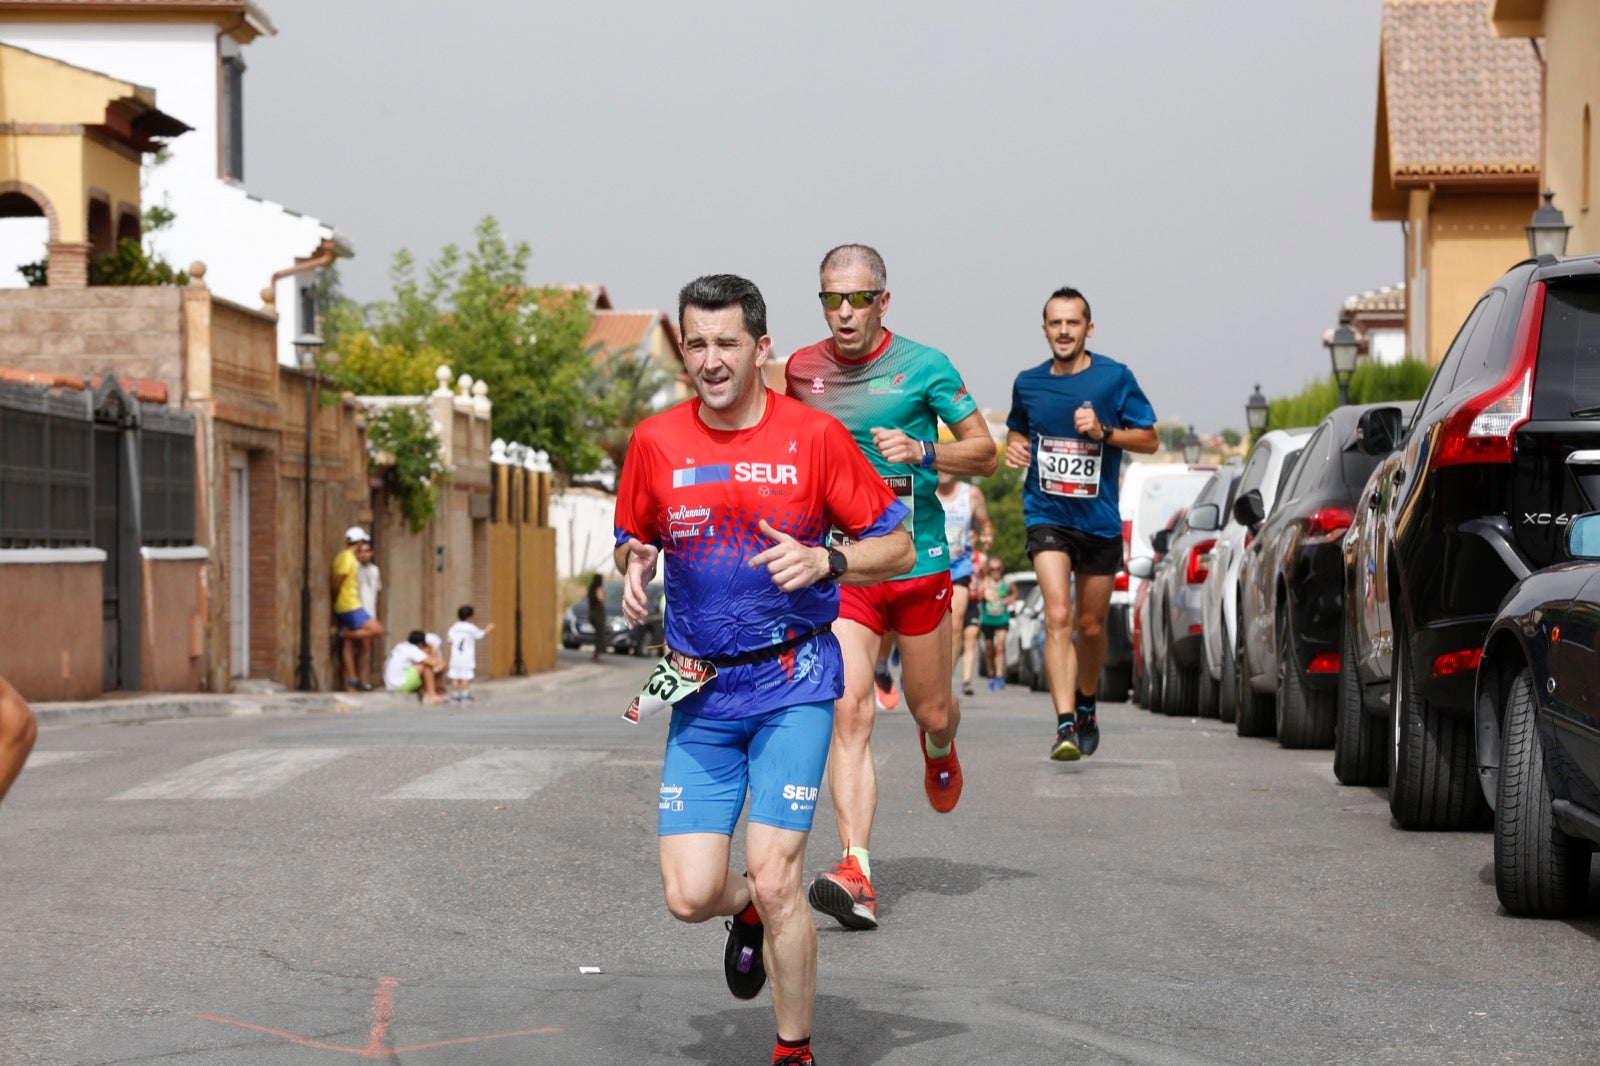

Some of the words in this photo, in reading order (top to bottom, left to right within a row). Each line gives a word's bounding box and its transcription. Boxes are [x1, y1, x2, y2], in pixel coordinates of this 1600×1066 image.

[734, 462, 798, 485] SEUR
[1043, 456, 1096, 477] 3028
[1522, 512, 1552, 525] XC
[782, 783, 818, 801] SEUR
